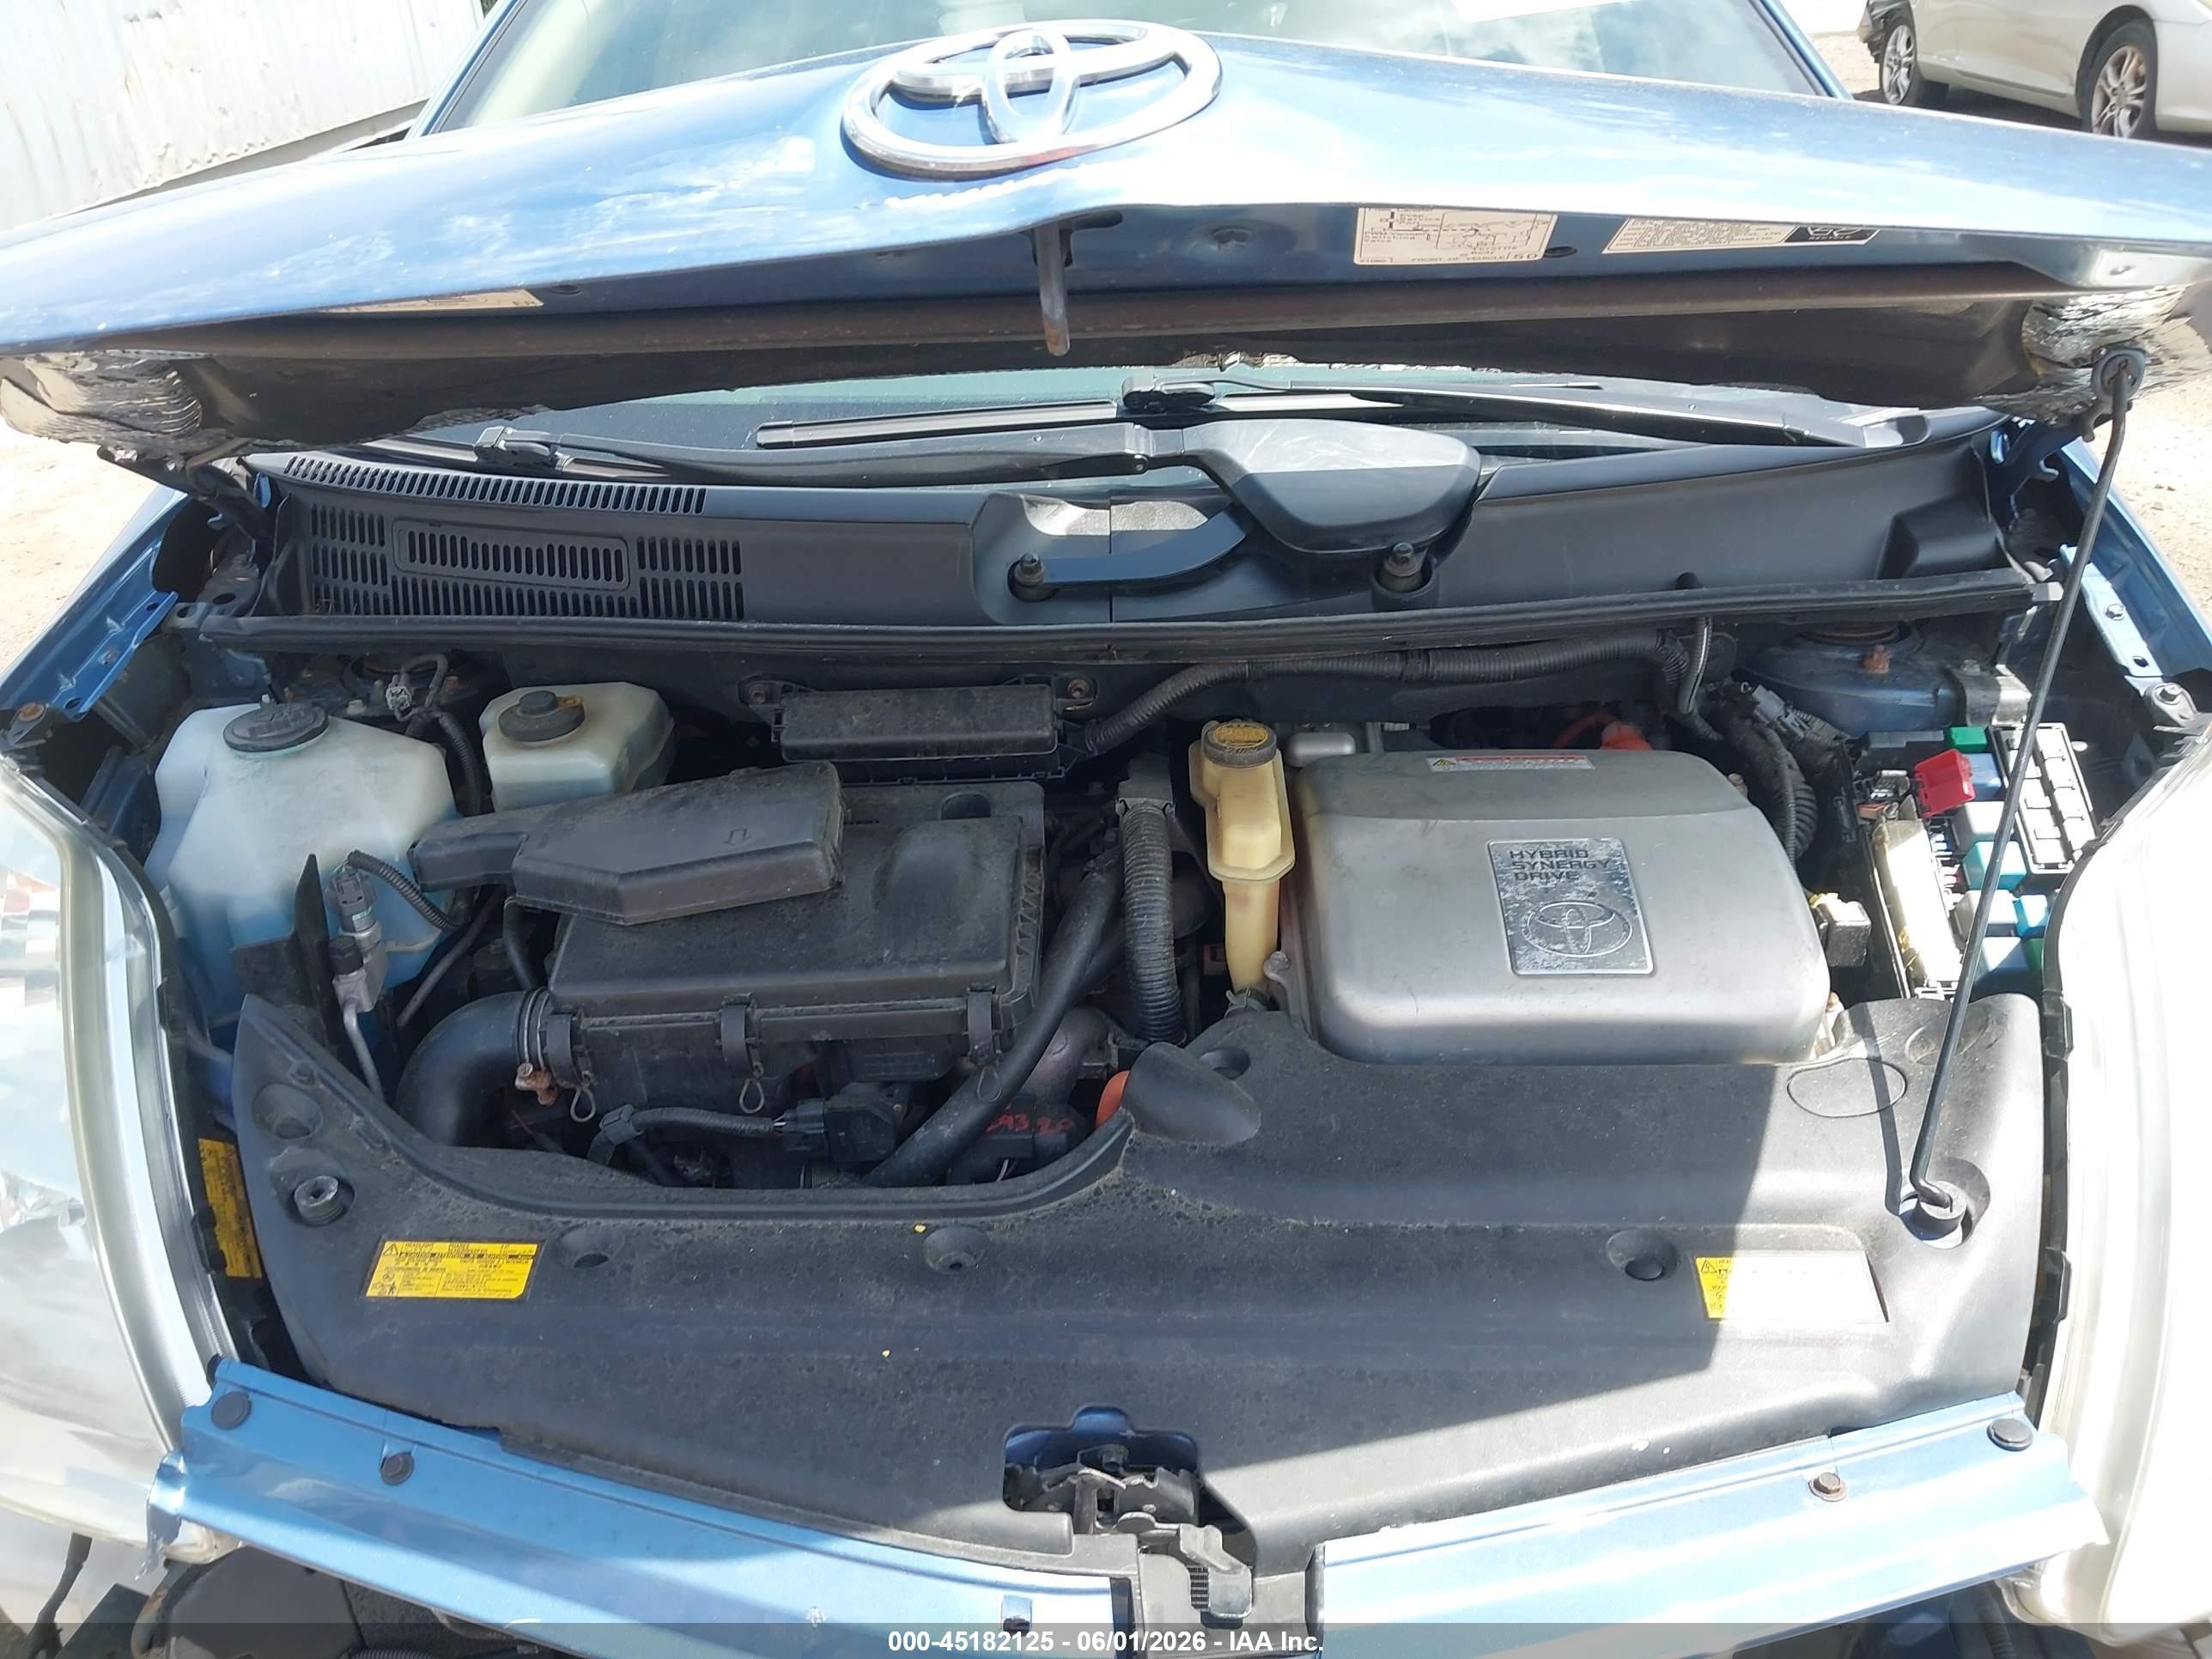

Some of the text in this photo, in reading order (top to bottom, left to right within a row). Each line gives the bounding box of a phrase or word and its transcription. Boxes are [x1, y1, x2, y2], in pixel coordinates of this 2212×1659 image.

[1510, 849, 1589, 860] HYBRID
[1511, 860, 1610, 870] SYNERGY
[1514, 872, 1580, 881] DRIVE
